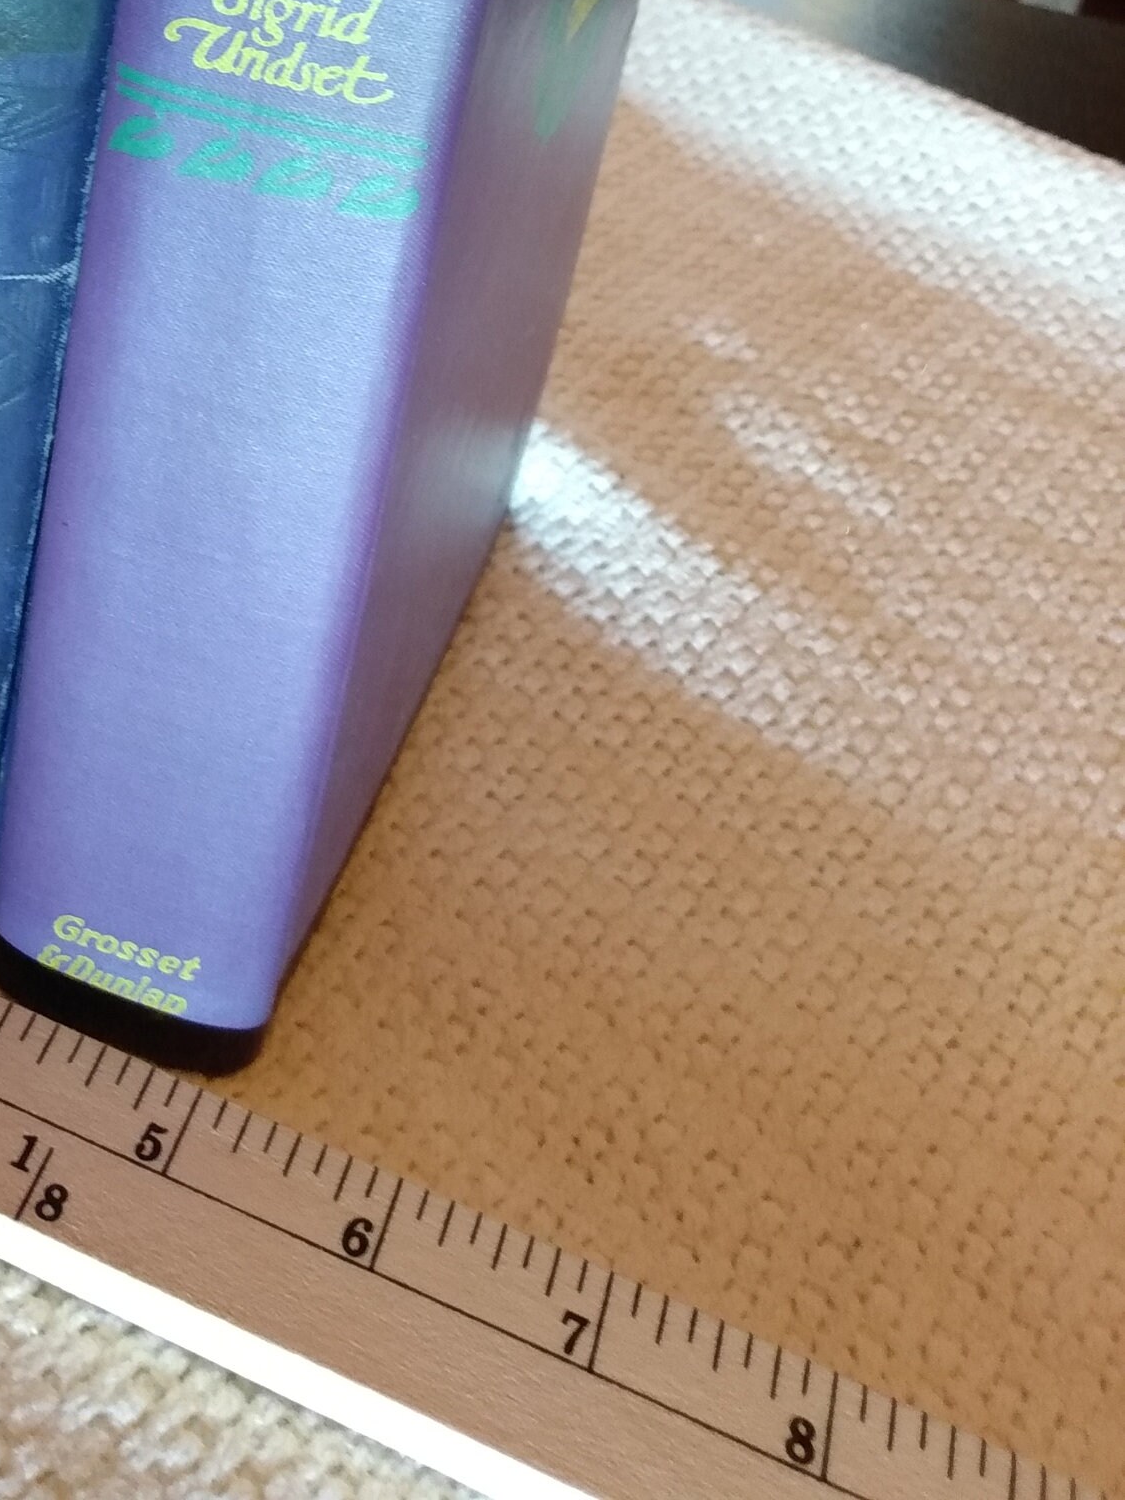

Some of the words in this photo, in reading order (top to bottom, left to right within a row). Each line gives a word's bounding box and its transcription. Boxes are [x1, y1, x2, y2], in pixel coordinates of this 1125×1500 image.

[164, 16, 395, 106] Undset
[52, 914, 202, 982] Grosset
[134, 1122, 167, 1162] 5
[340, 1217, 372, 1259] 6
[560, 1310, 591, 1356] 7
[784, 1415, 817, 1466] 8
